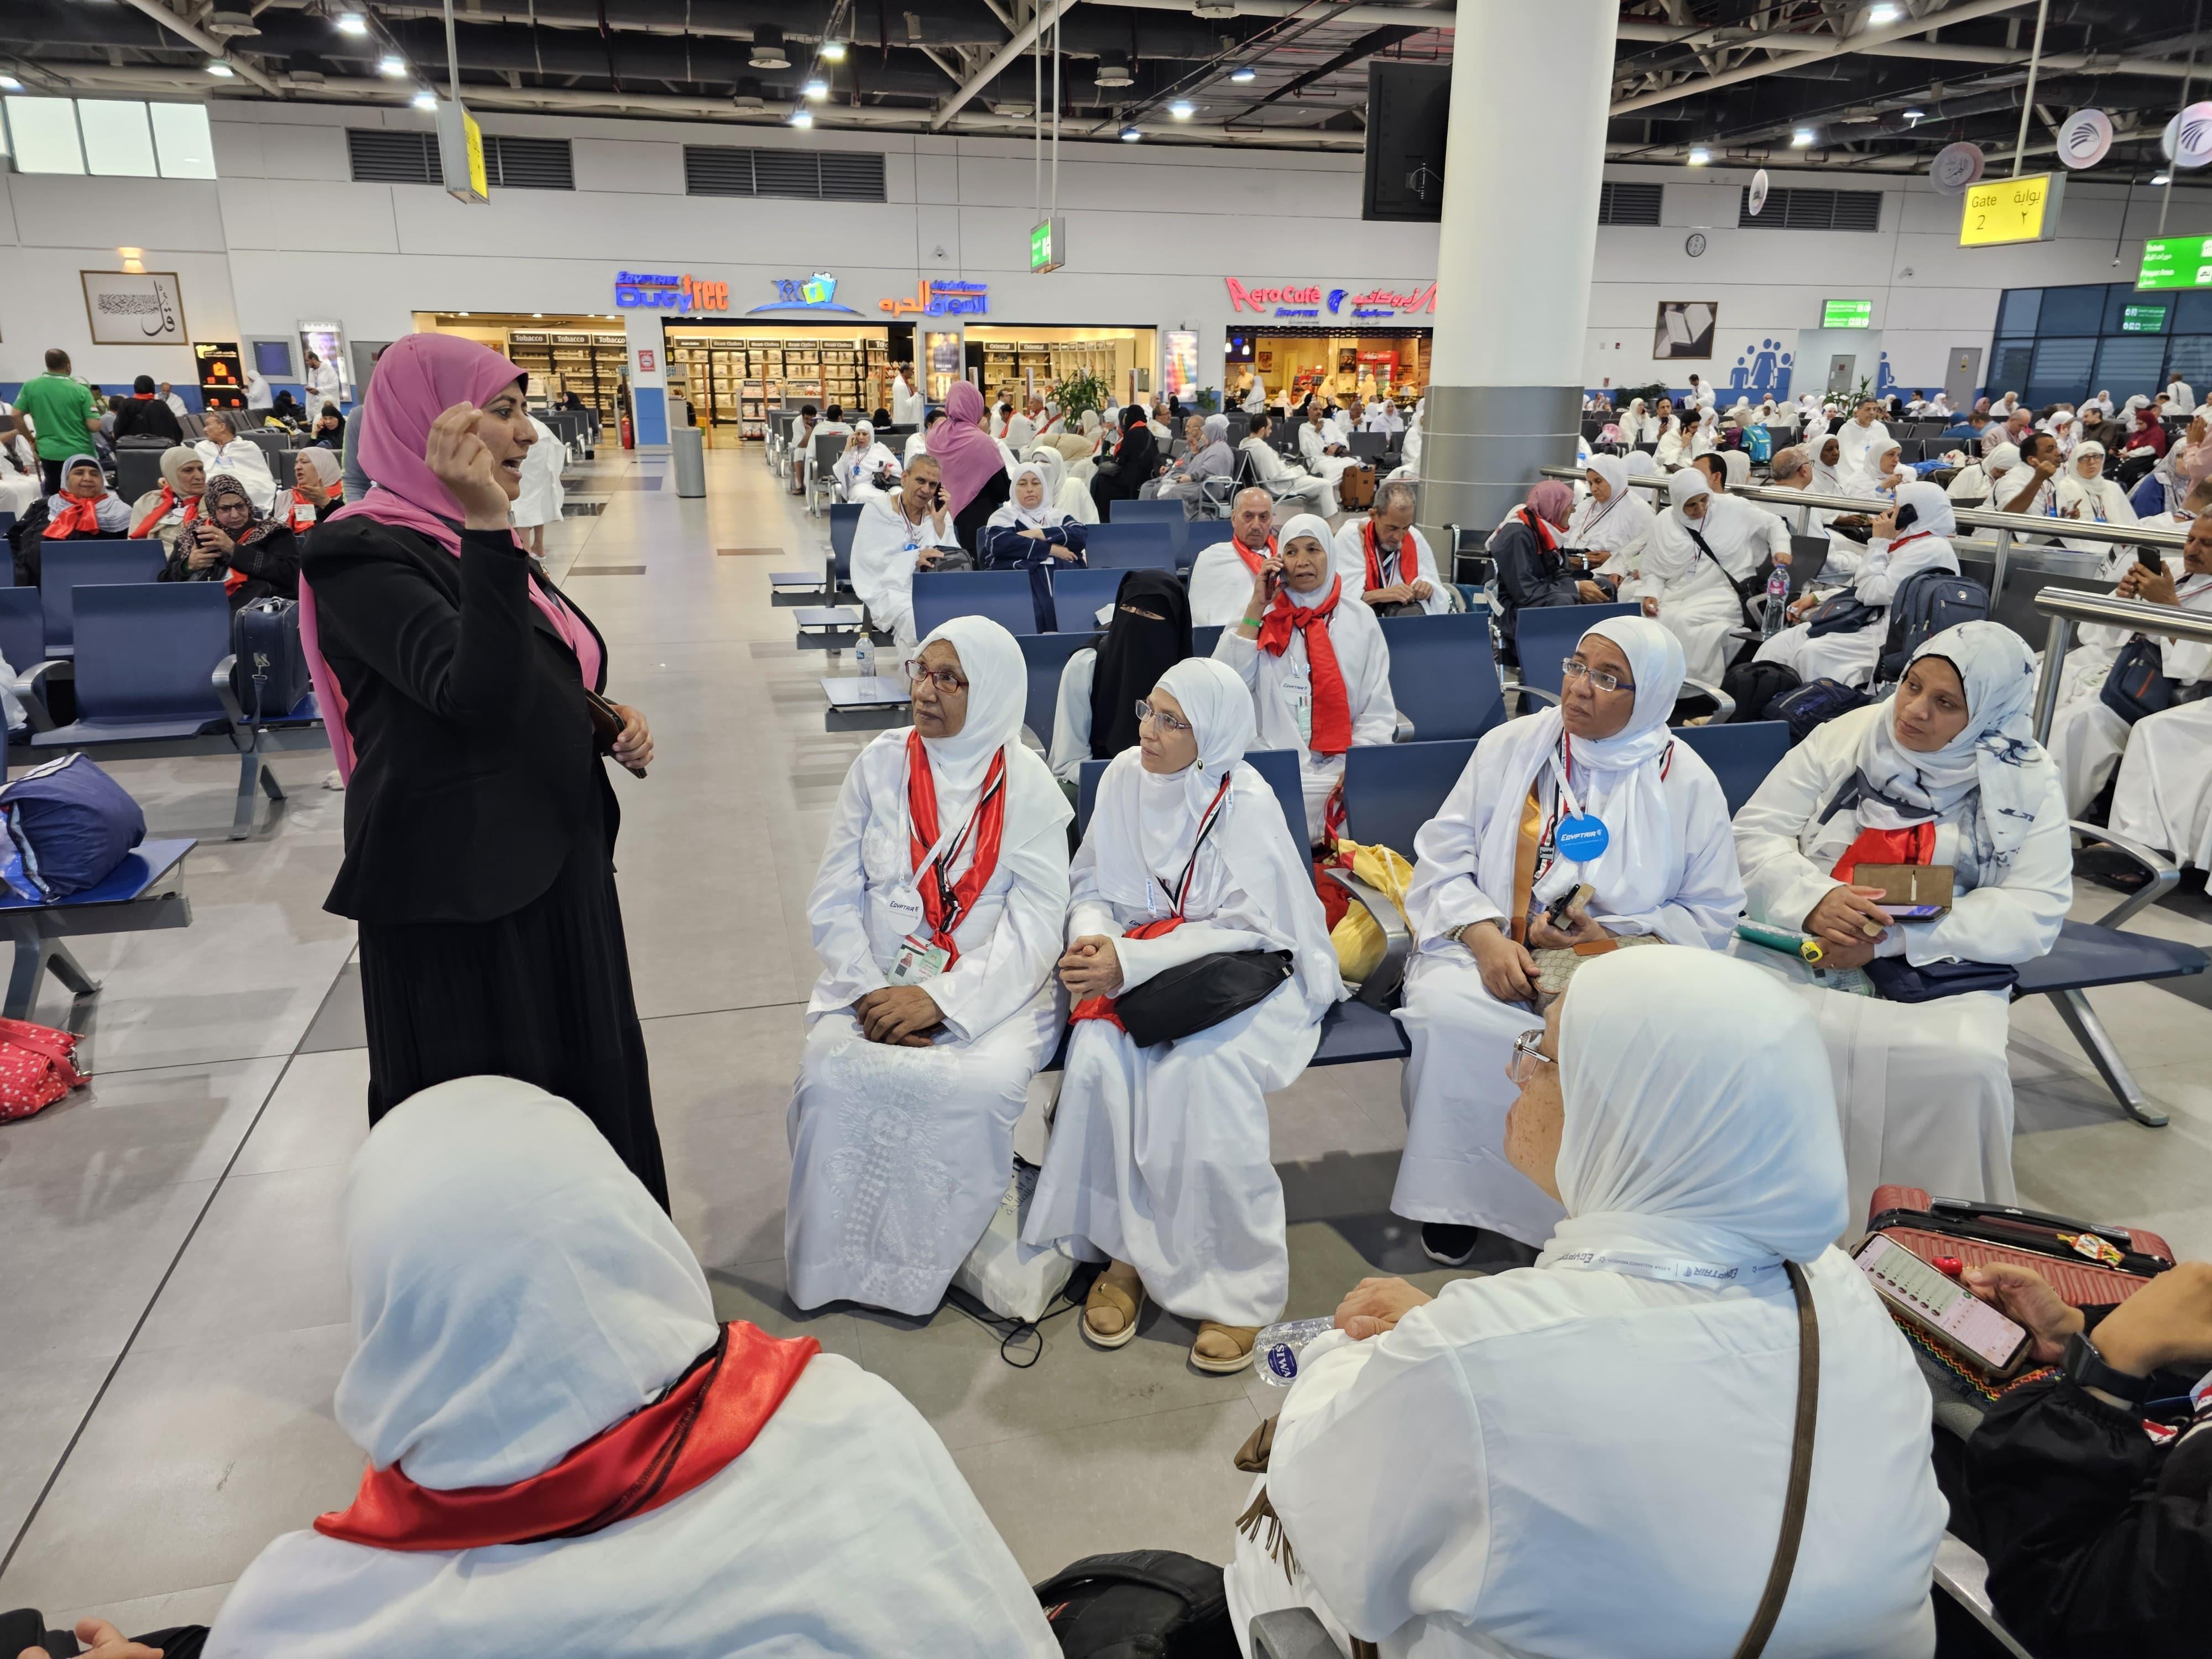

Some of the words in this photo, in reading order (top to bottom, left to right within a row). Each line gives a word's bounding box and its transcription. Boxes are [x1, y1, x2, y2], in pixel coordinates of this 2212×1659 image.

[1971, 195, 1997, 208] Gate
[2013, 189, 2041, 206] بوابة
[1976, 215, 1986, 231] 2
[616, 286, 693, 314] Duty
[682, 274, 729, 310] free
[1225, 276, 1282, 312] Aero
[1282, 284, 1321, 304] Café
[515, 334, 543, 342] Tobacco
[1561, 831, 1596, 841] EGYPTAIR
[890, 900, 915, 912] EGYPTAIR
[1693, 1267, 1739, 1279] EGYPTAIR
[1276, 1344, 1292, 1378] SIWA
